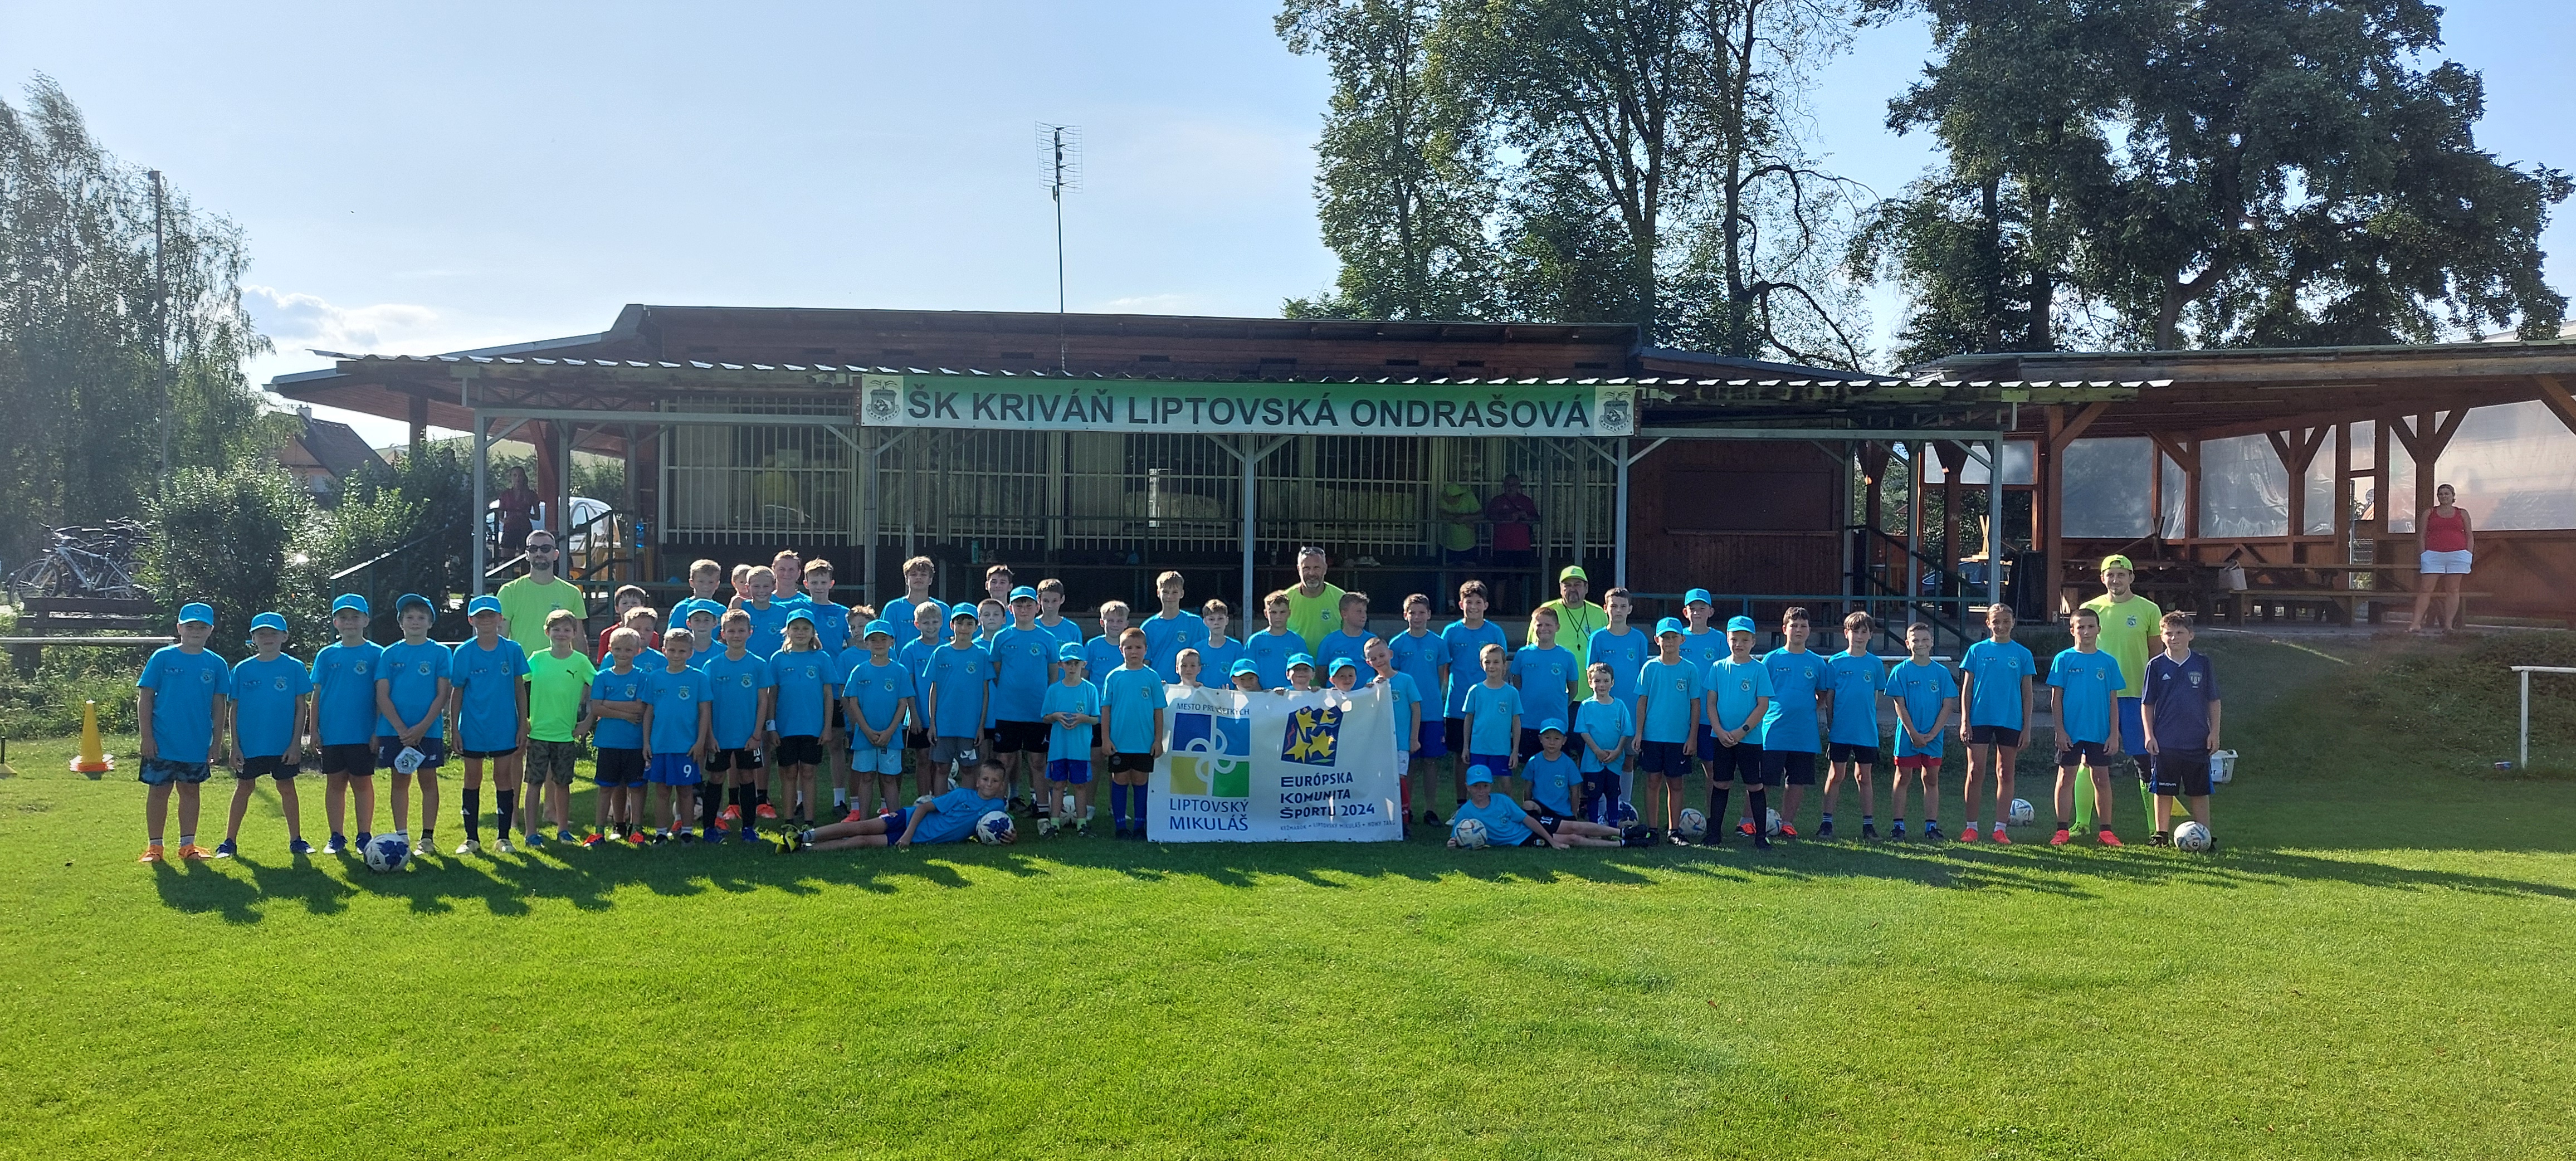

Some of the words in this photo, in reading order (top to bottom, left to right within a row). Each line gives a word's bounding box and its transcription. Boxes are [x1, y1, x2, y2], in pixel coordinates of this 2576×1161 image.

[908, 383, 960, 419] ŠK
[972, 388, 1114, 423] KRIVÁŇ
[1128, 392, 1339, 427] LIPTOVSKÁ
[1350, 393, 1591, 428] ONDRAŠOVÁ
[683, 764, 692, 778] 9
[1281, 772, 1354, 788] EURÓPSKA
[1280, 789, 1351, 804] KOMUNITA
[1170, 798, 1249, 813] LIPTOVSKÝ
[1280, 807, 1336, 819] ŠPORTU
[1341, 803, 1375, 816] 2024
[1170, 814, 1248, 831] MIKULÁŠ
